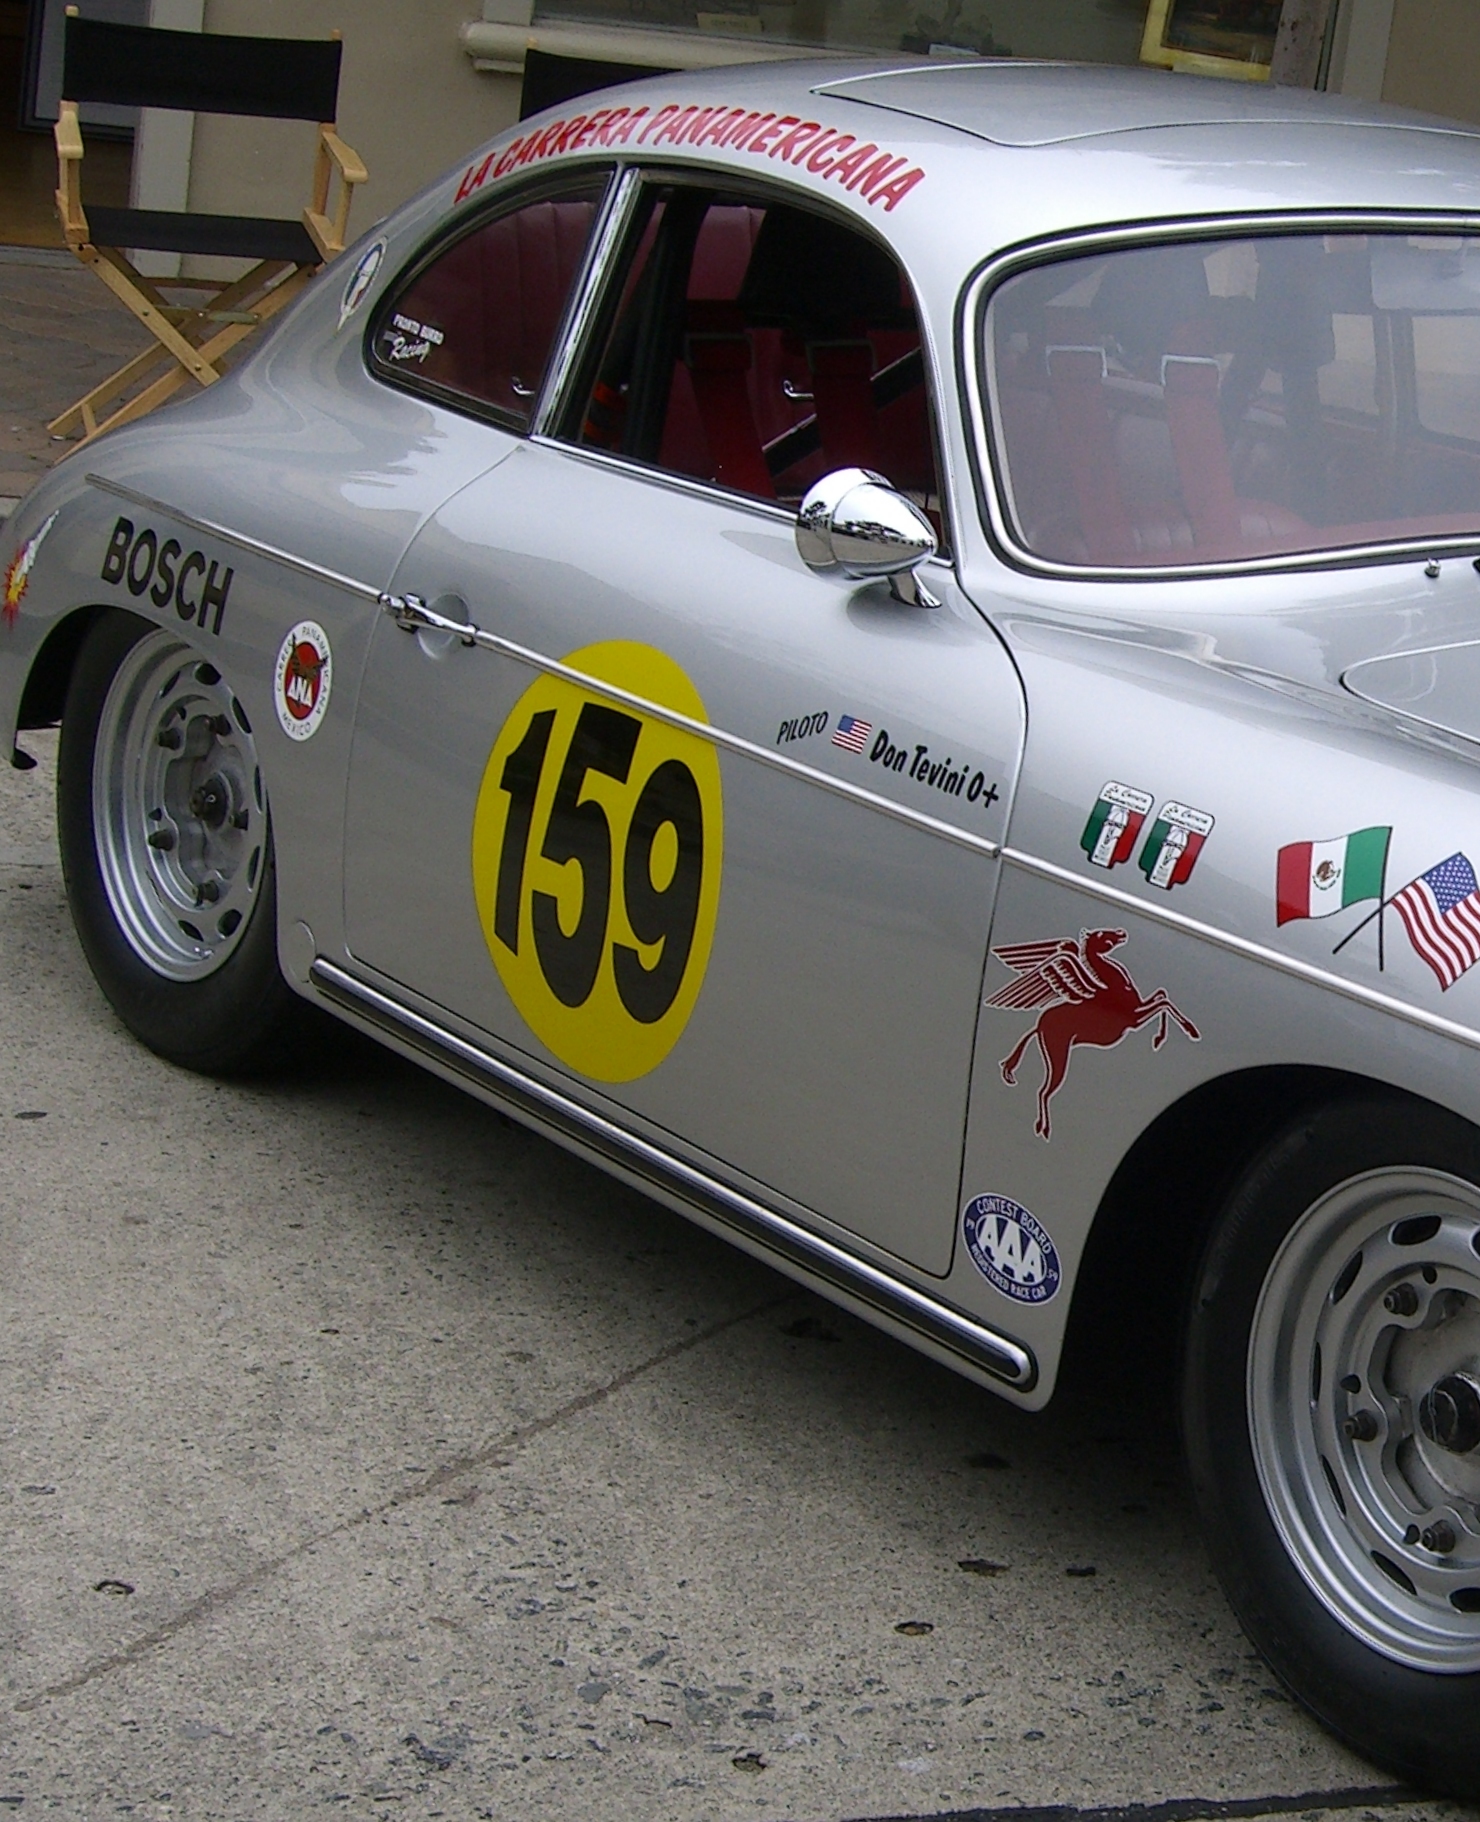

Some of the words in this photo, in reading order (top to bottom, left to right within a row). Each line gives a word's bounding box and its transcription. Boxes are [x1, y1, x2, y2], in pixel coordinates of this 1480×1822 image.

[453, 153, 494, 205] LA
[493, 105, 650, 179] CARRERA
[636, 104, 926, 212] PANAMERICANA
[101, 515, 235, 637] BOSCH
[776, 710, 829, 746] PILOTO
[869, 729, 908, 773] Don
[908, 744, 970, 797] Tevini
[494, 702, 704, 1025] 159
[976, 1197, 1019, 1219] CONTEST
[1019, 1212, 1053, 1254] BOARD
[977, 1213, 1048, 1285] AAA
